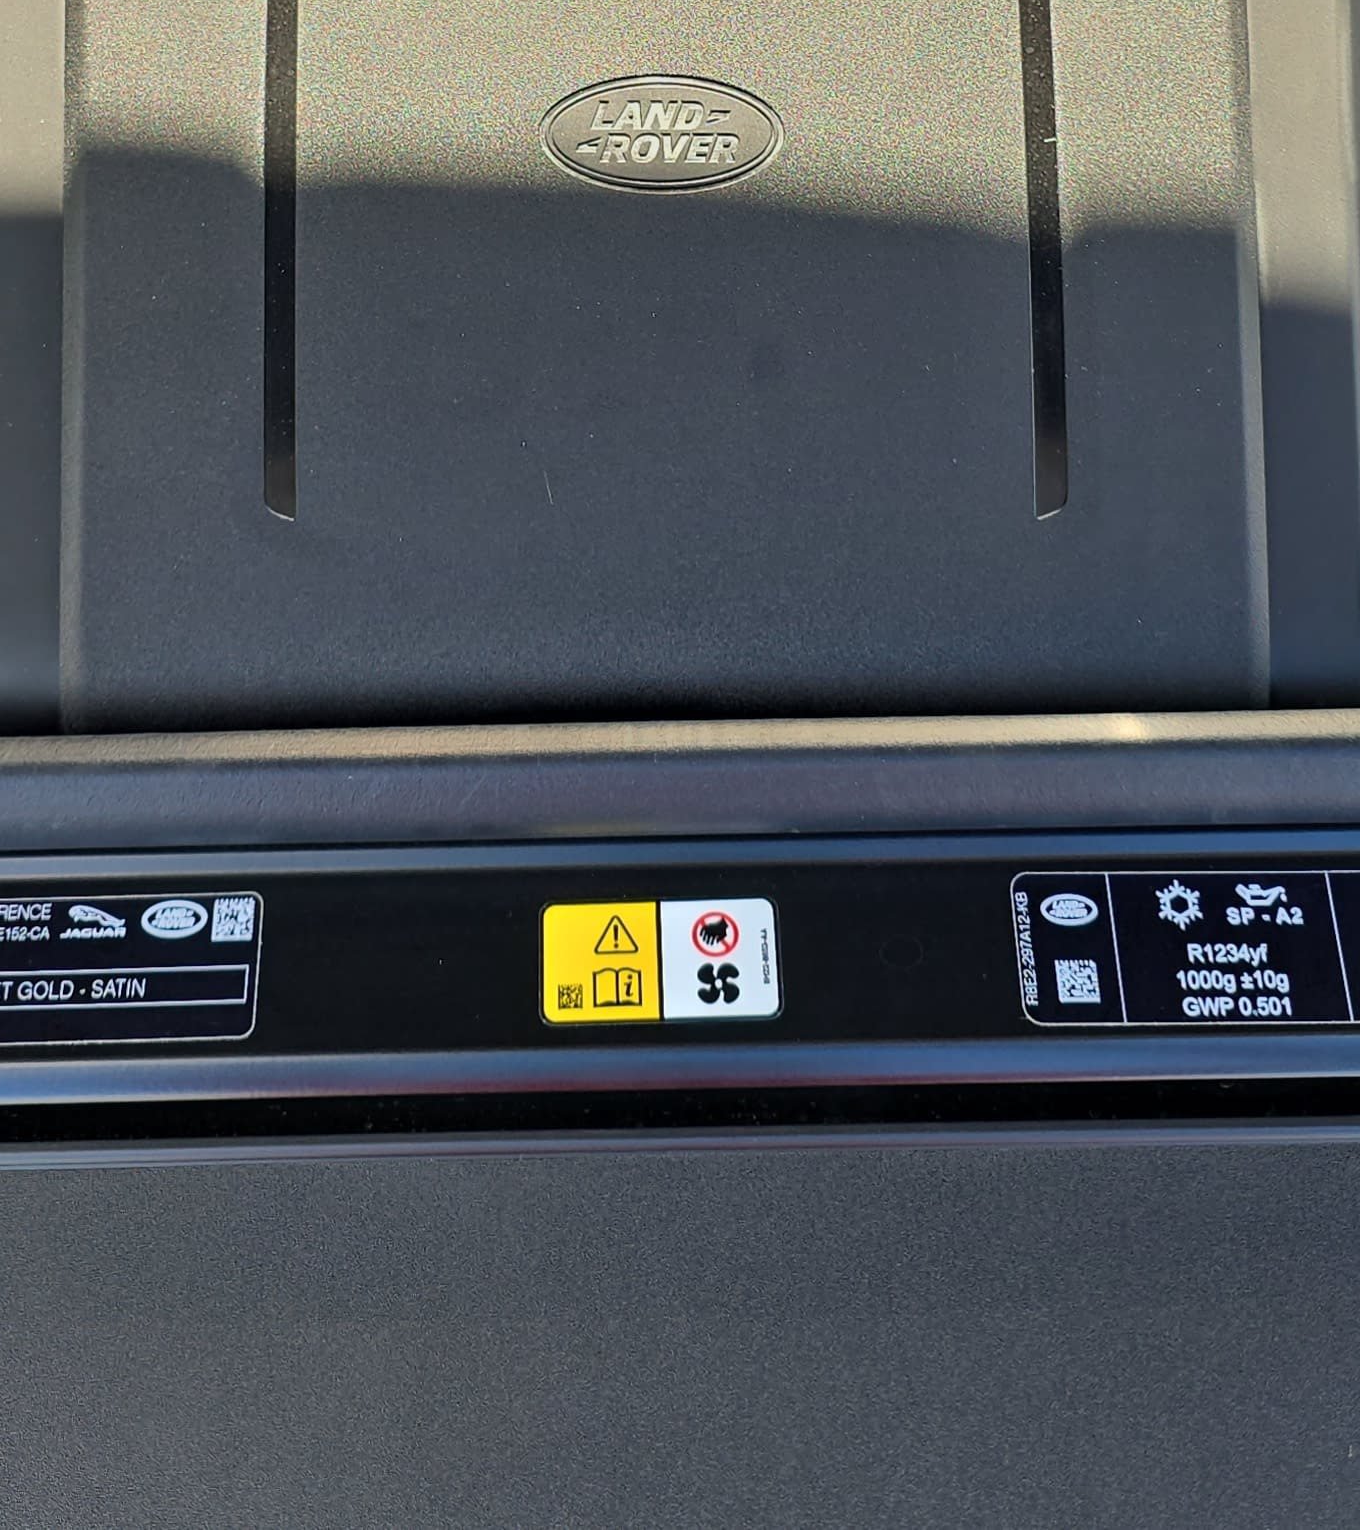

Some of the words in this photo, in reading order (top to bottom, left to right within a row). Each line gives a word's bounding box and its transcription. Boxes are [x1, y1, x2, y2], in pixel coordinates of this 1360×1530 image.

[590, 99, 705, 131] LAND
[599, 132, 741, 164] ROVER
[1226, 907, 1254, 925] SP
[1275, 907, 1304, 925] A2
[59, 926, 127, 940] JAGUAR
[1186, 943, 1269, 967] R1234yf
[16, 980, 74, 1002] GOLD
[91, 978, 146, 999] SATIN
[1176, 970, 1237, 993] 1000g
[1240, 970, 1290, 993] ±10g
[1182, 997, 1234, 1017] GWP
[1238, 997, 1292, 1016] 0.501
